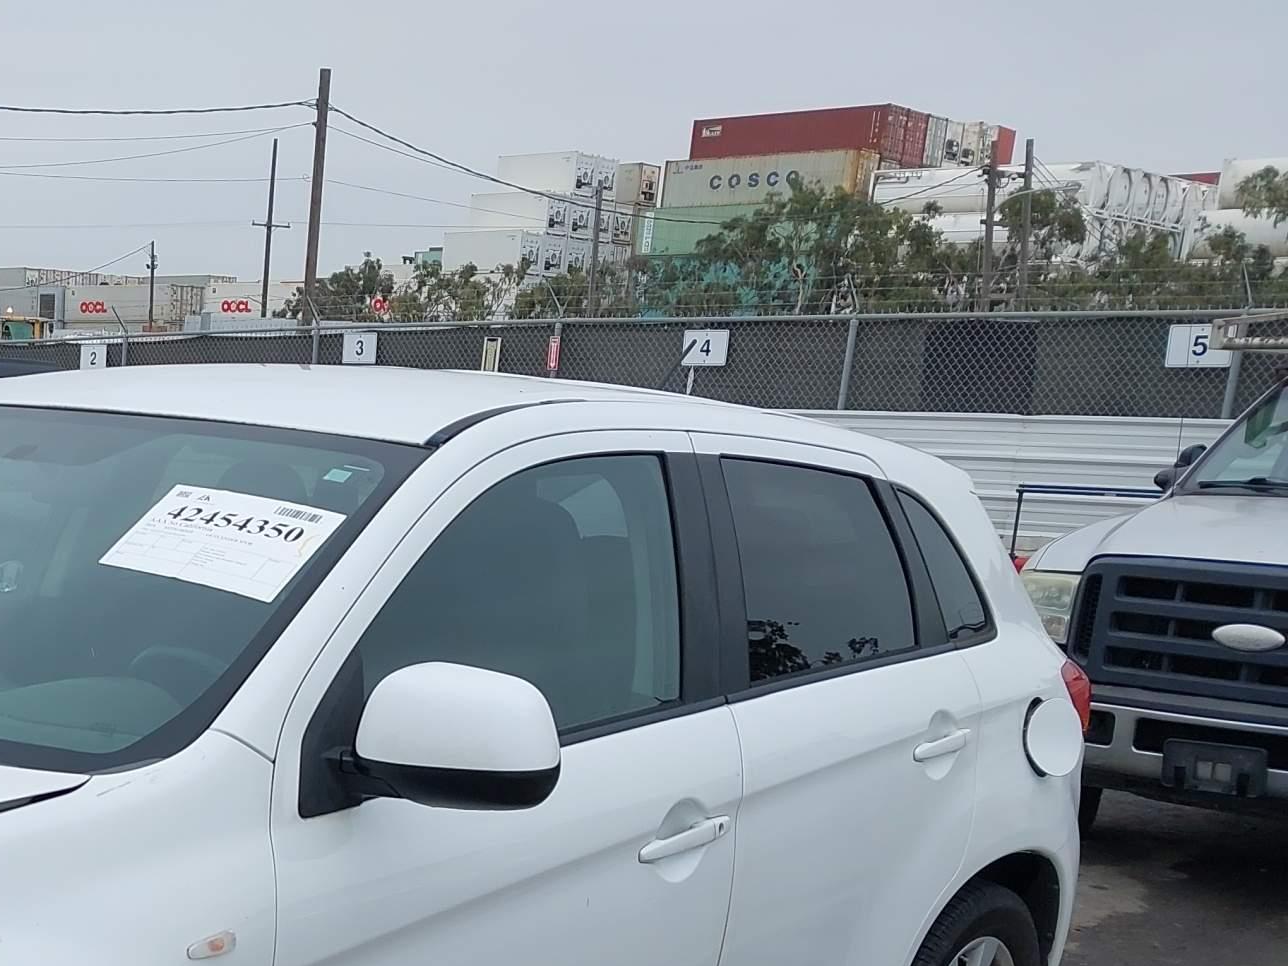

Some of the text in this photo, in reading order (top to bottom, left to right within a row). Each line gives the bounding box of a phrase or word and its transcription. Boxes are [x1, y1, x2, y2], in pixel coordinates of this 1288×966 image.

[709, 170, 800, 190] COSCO
[80, 301, 108, 314] OOCL
[221, 300, 252, 313] OOCL
[355, 340, 364, 356] 3
[699, 339, 712, 357] 4
[1192, 335, 1209, 356] 5
[89, 351, 97, 366] 2
[167, 505, 305, 543] 42454350
